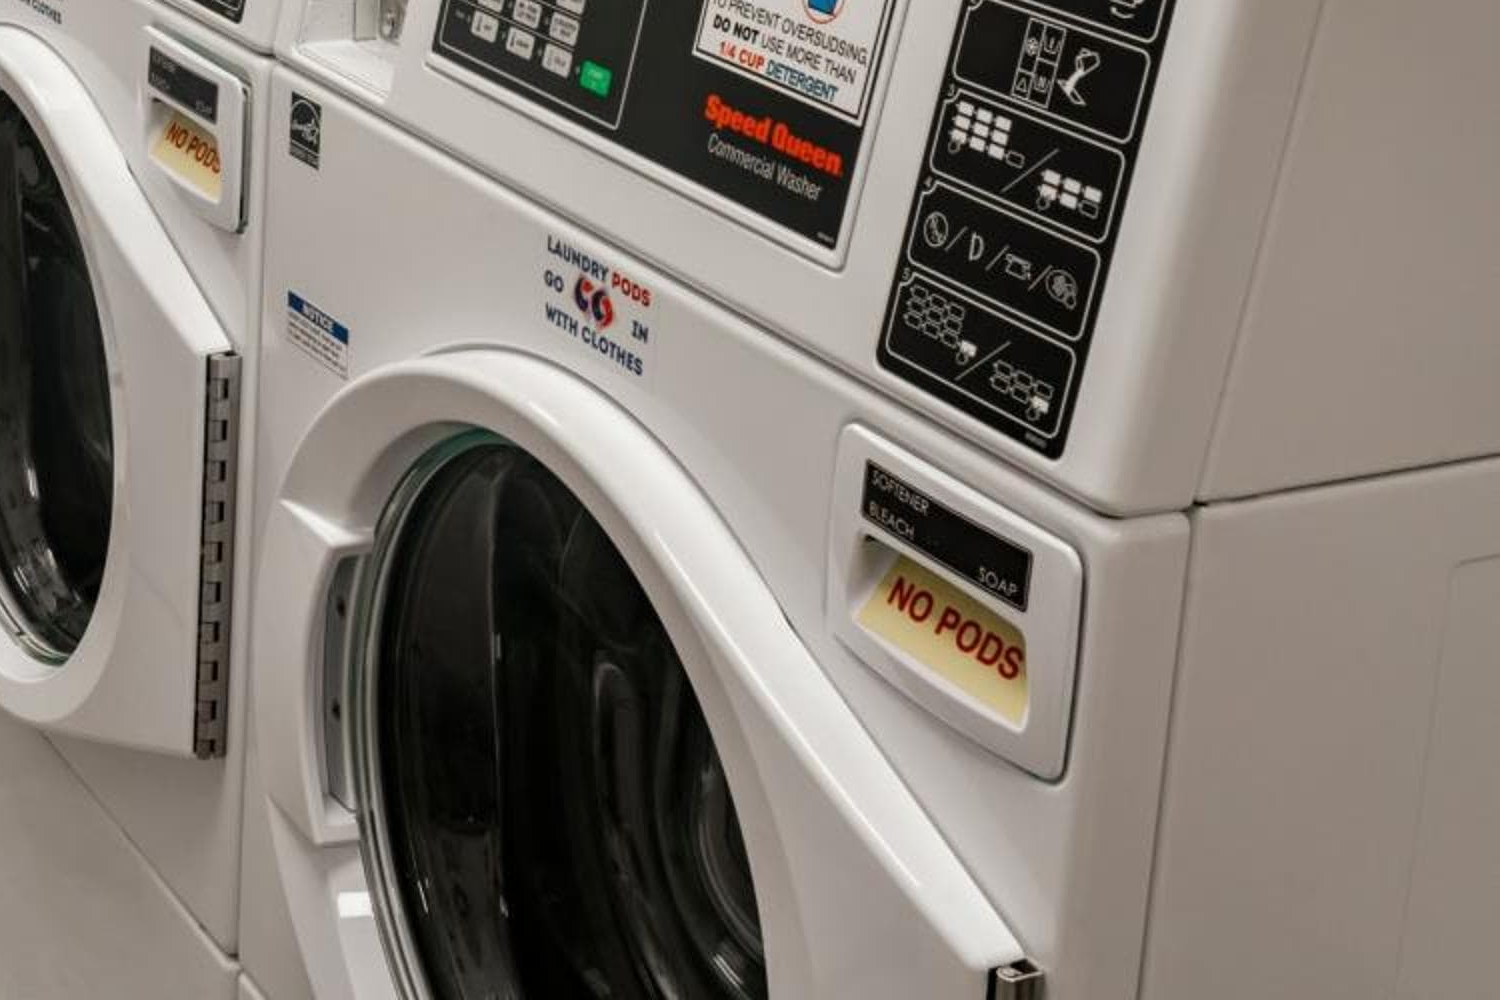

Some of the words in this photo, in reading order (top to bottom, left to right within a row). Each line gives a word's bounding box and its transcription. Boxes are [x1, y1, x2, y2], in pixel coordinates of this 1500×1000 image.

[713, 14, 731, 32] DO
[733, 21, 760, 44] NOT
[761, 31, 784, 54] USE
[785, 41, 821, 70] MORE
[824, 57, 857, 85] THAN
[719, 41, 737, 58] 1/4
[738, 49, 767, 69] CUP
[766, 59, 840, 102] DETERGENT
[164, 120, 189, 149] NO
[705, 93, 773, 144] Speed
[771, 122, 843, 177] Queen
[707, 132, 777, 181] Commercial
[775, 162, 823, 201] Washer
[544, 269, 565, 294] GO
[547, 234, 609, 283] LAUNDRY
[611, 271, 652, 308] PODS
[545, 302, 578, 338] WITH
[581, 325, 644, 377] CLOTHES
[631, 319, 650, 344] IN
[867, 500, 916, 538] BLEACH
[870, 467, 930, 516] SOFTENER
[977, 566, 1018, 598] SOAP
[887, 575, 934, 625] NO
[934, 604, 1026, 682] PODS
